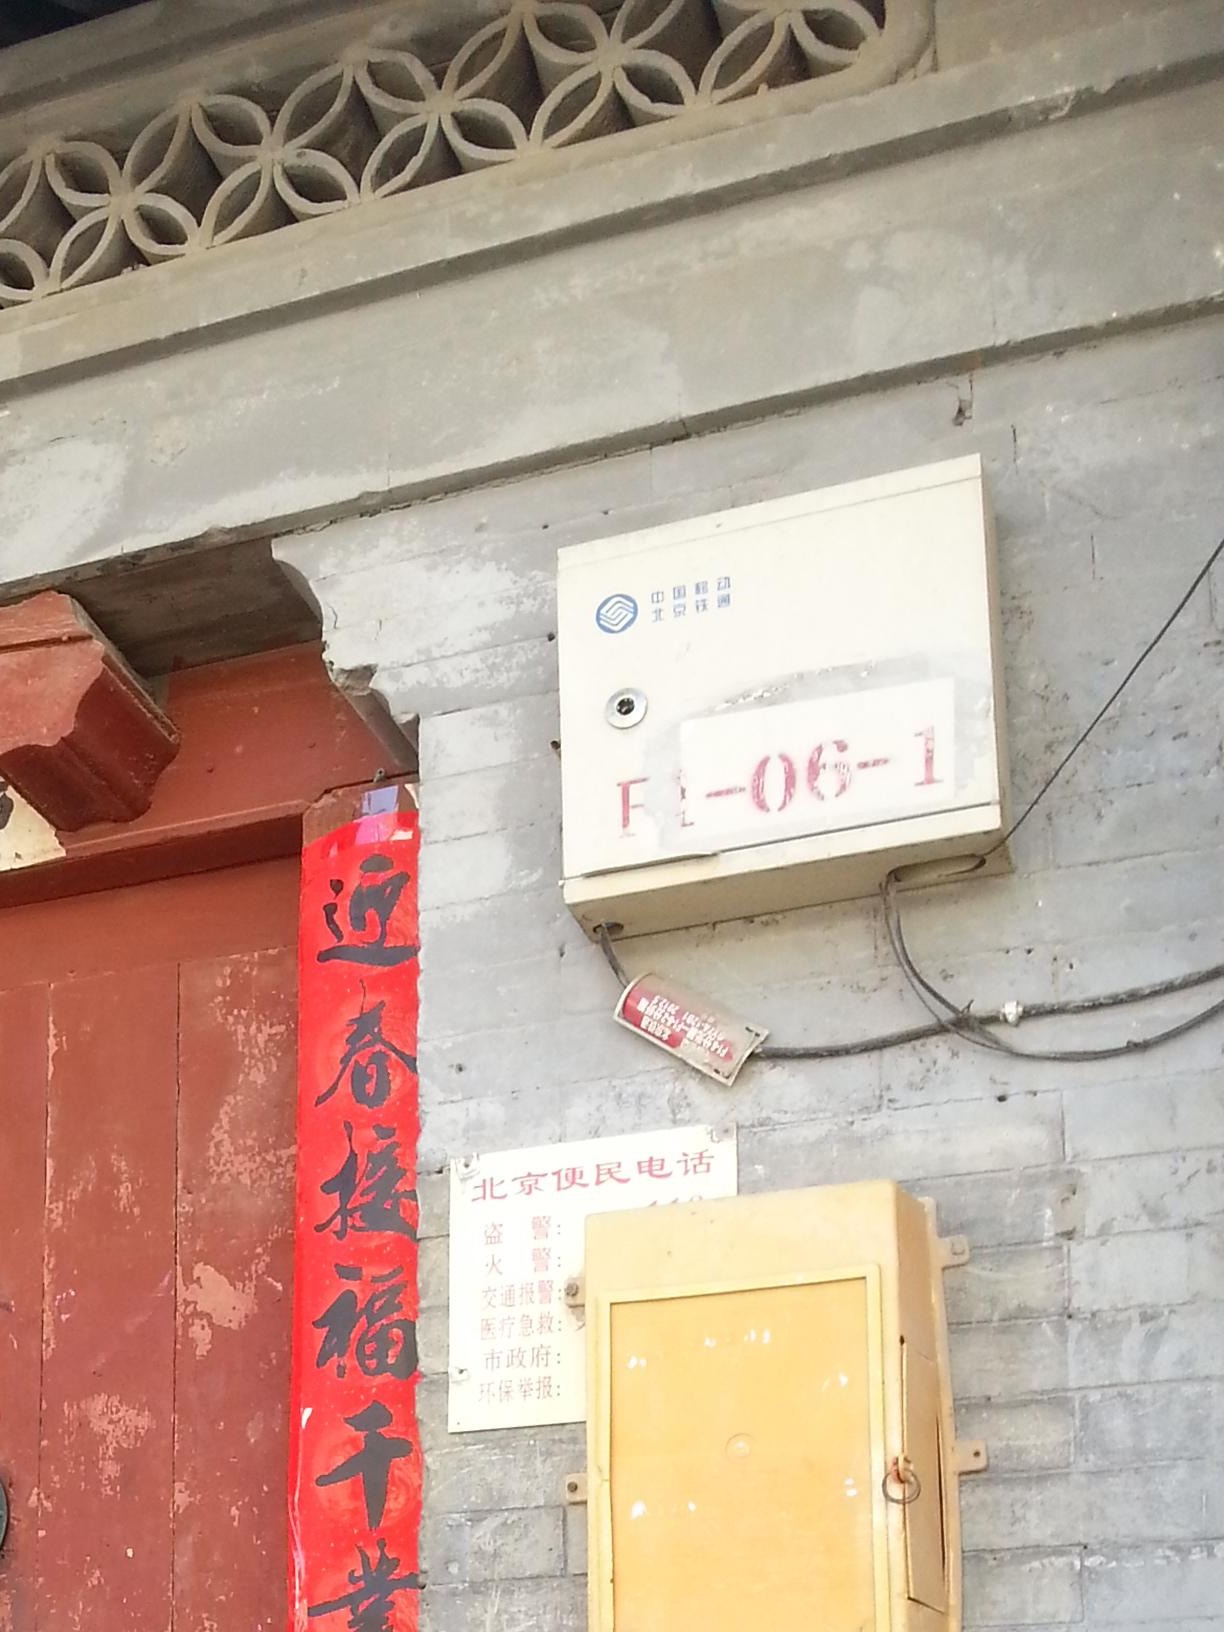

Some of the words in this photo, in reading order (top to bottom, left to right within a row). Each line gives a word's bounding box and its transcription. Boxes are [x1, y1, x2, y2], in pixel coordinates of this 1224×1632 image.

[472, 1149, 715, 1202] 北京便民电话
